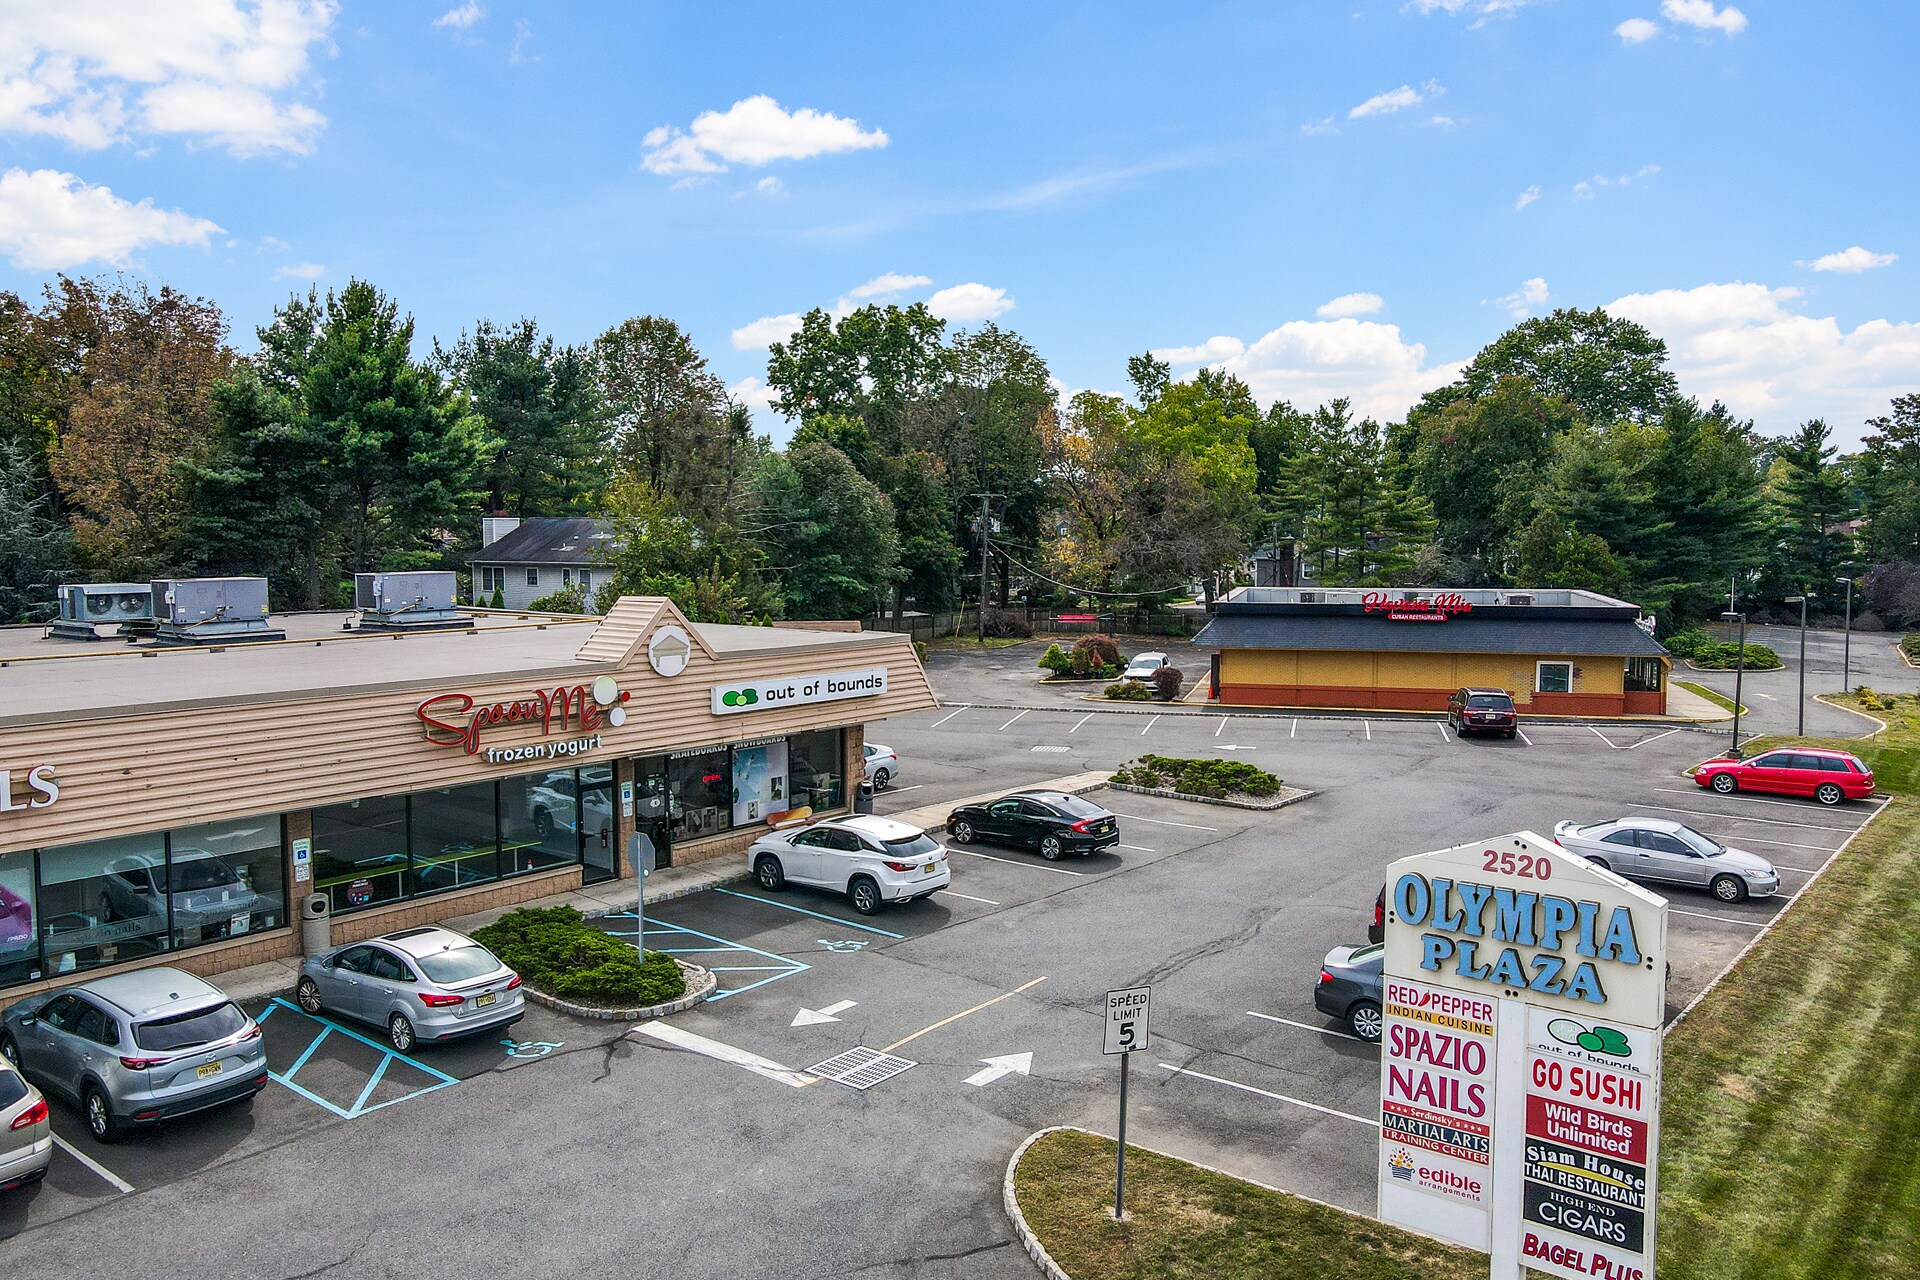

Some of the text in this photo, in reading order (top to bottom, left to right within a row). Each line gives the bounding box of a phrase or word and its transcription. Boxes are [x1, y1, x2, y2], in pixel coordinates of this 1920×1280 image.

[1362, 591, 1473, 614] Havana Mia
[766, 675, 883, 701] out of bounds
[487, 735, 603, 763] frozen yogurt
[0, 763, 60, 812] LS
[1482, 849, 1551, 880] 2520
[1394, 872, 1642, 965] OLYMPIA
[1420, 933, 1608, 1004] PLAZA
[1110, 993, 1147, 1008] SPEED
[1113, 1008, 1142, 1021] LIMIT
[1388, 984, 1492, 1022] RED PEPPER
[1119, 1021, 1135, 1045] 5
[1389, 1004, 1491, 1035] INDIAN CUISINE
[1390, 1024, 1486, 1076] SPAZIO
[1538, 1044, 1640, 1073] out of bounds
[1389, 1064, 1486, 1118] NAILS
[1532, 1058, 1641, 1111] GO SUSHI
[1384, 1113, 1488, 1152] MARTIAL ARTS
[1410, 1108, 1461, 1127] Serdinsky's
[1544, 1102, 1633, 1138] Wild Birds
[1384, 1129, 1488, 1164] TRAINING CENTER
[1547, 1120, 1631, 1155] Unlimited
[1418, 1167, 1481, 1194] edible
[1524, 1162, 1646, 1208] THAI RESTAURANT
[1526, 1146, 1645, 1190] Siam House
[1419, 1180, 1481, 1202] arrangements
[1550, 1191, 1616, 1217] HIGH END
[1538, 1202, 1626, 1243] CIGARS
[1522, 1232, 1643, 1280] BAGEL PLUS
